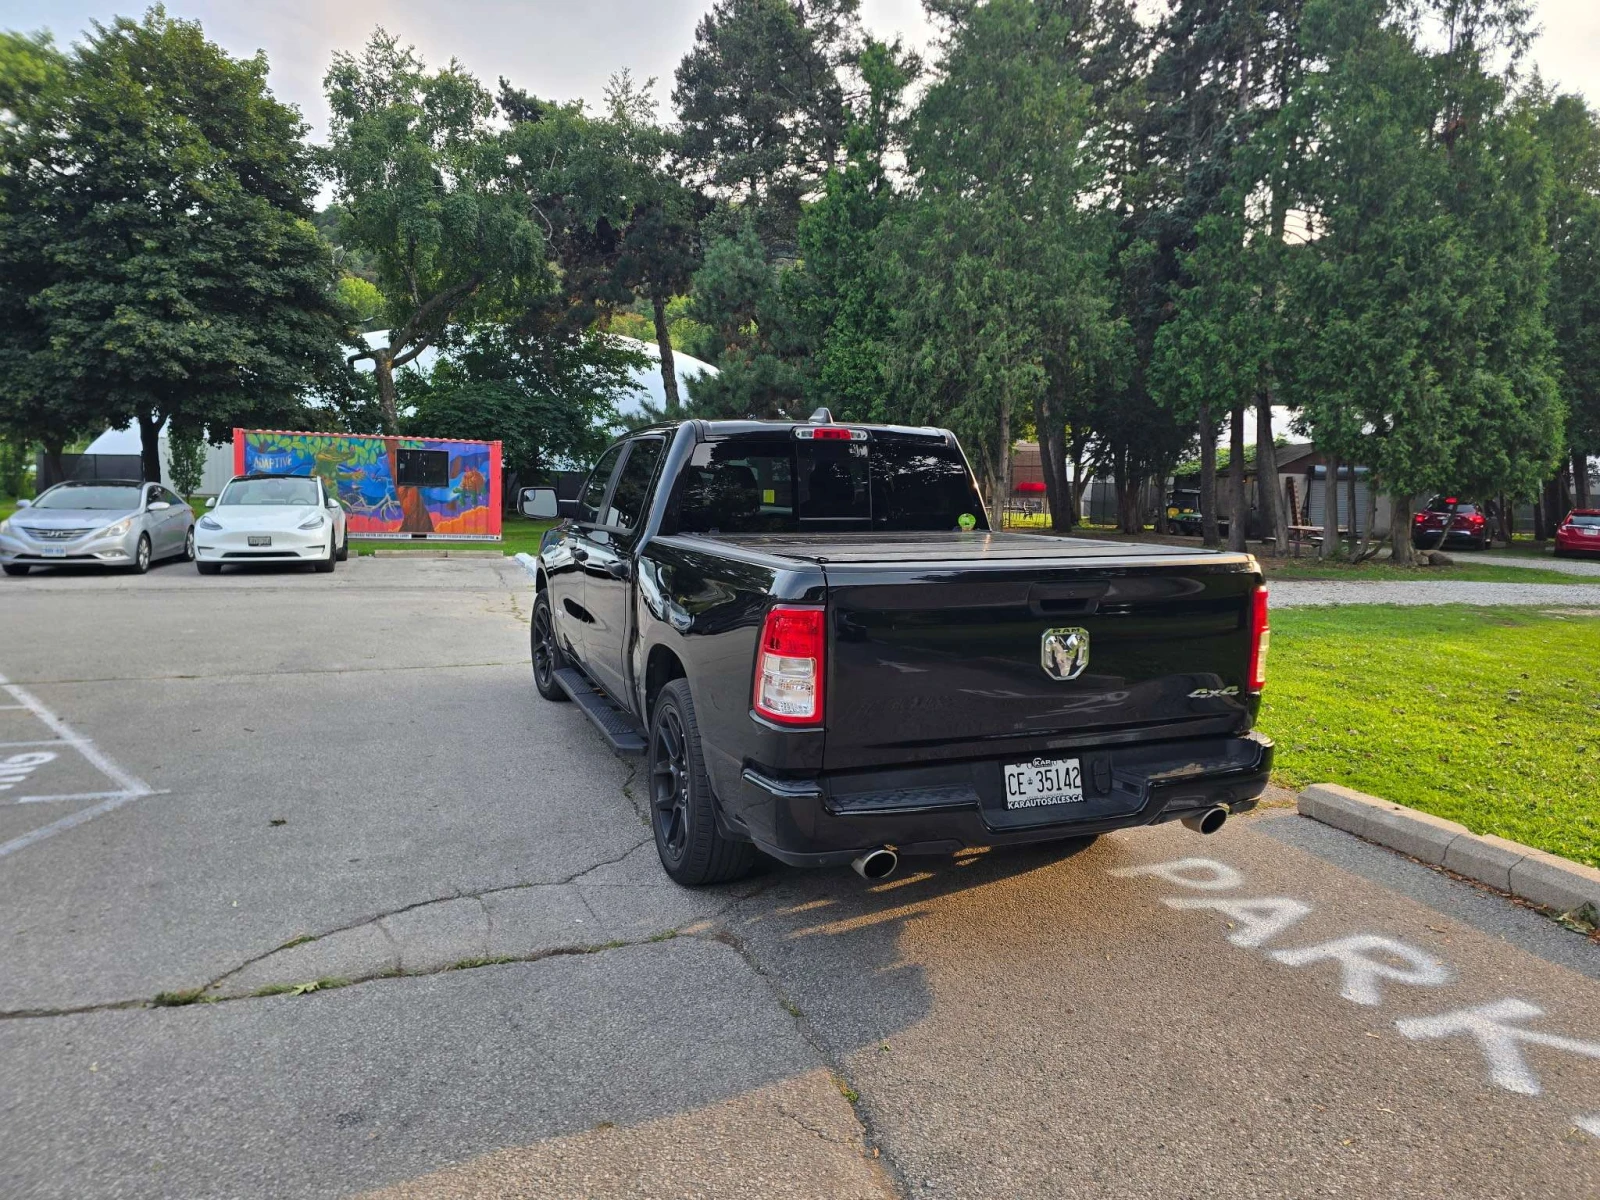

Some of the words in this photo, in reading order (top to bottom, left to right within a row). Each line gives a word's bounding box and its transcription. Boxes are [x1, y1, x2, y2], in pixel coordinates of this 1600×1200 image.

[1008, 773, 1026, 795] CE
[1036, 767, 1081, 792] 35142
[1008, 795, 1083, 809] KARAUTOSALES.CA
